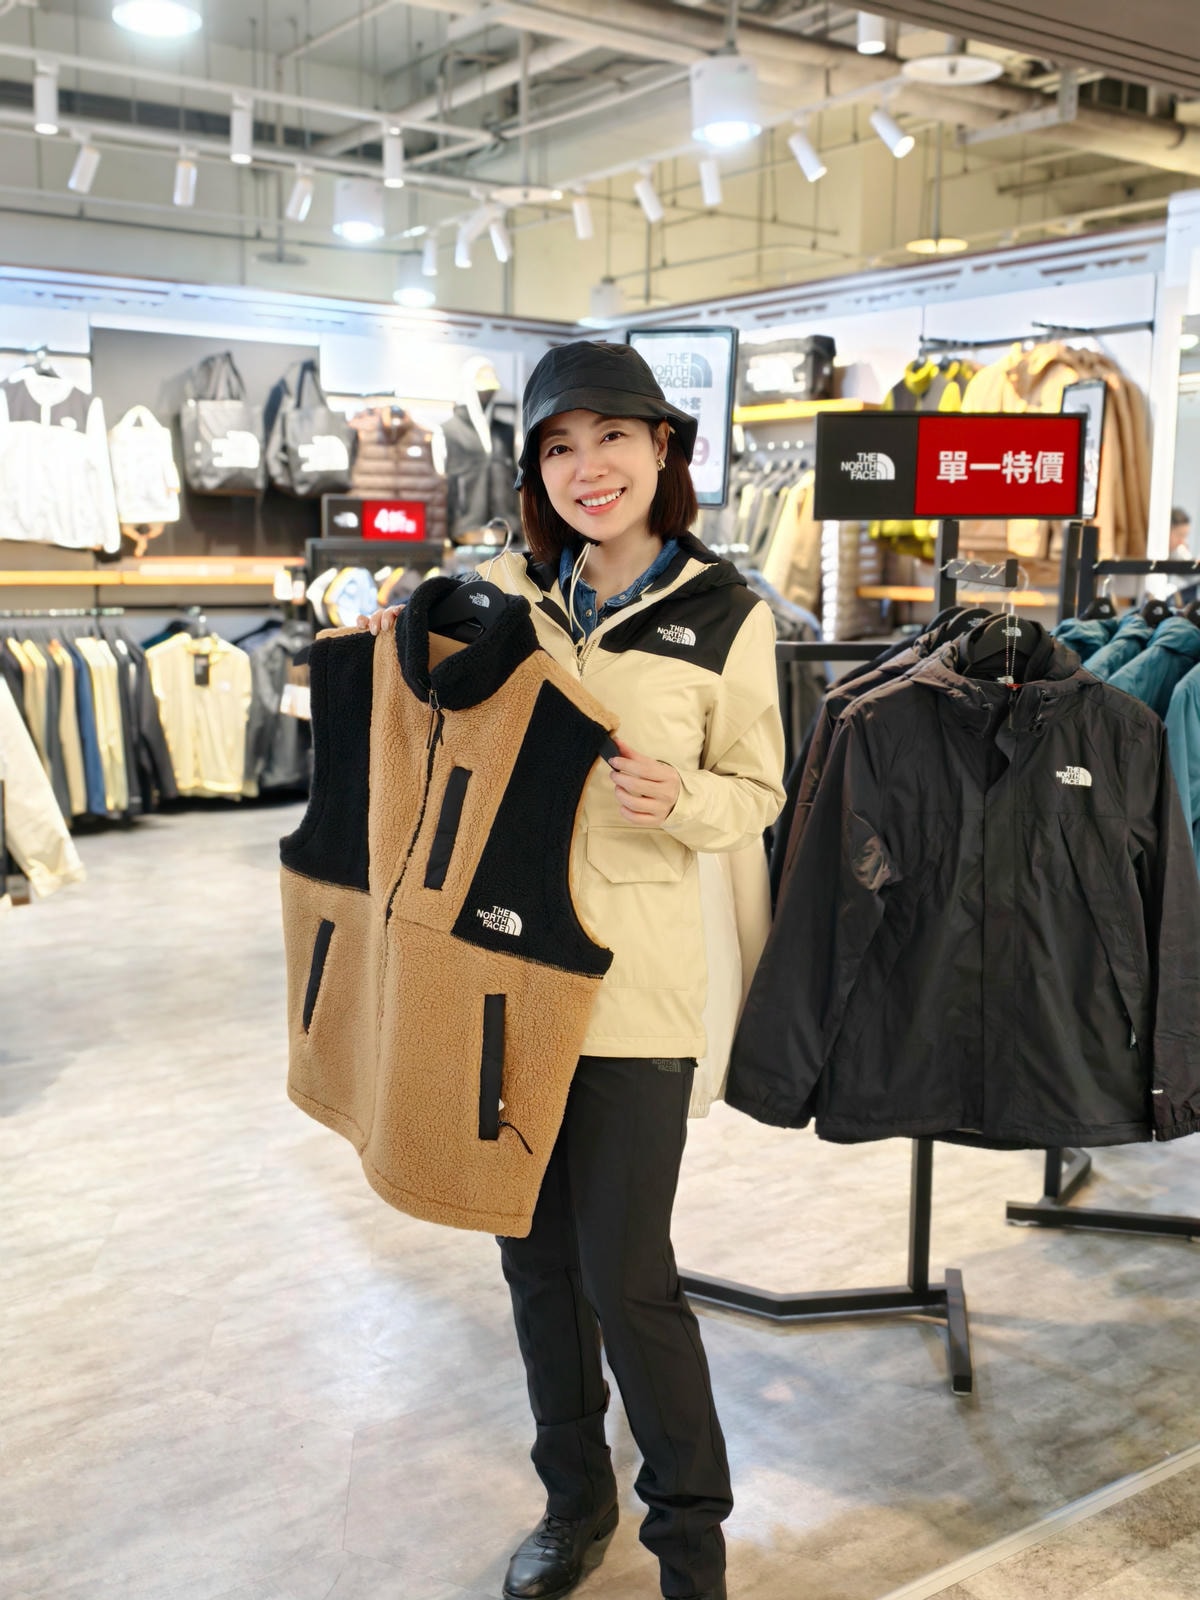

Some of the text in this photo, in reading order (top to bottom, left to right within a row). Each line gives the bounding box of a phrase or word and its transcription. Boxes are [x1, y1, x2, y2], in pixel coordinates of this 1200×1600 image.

[667, 353, 689, 364] THE
[658, 377, 688, 388] FACE
[857, 452, 877, 462] THE
[841, 461, 877, 471] NORTH
[936, 450, 1064, 484] 單一特價
[851, 470, 877, 480] FACE
[657, 627, 684, 639] NORTH
[670, 624, 685, 634] THE
[662, 634, 682, 644] FACE
[1066, 765, 1080, 773] THE
[1056, 770, 1080, 780] NORTH
[1061, 778, 1080, 786] FACE
[492, 905, 510, 918] THE
[476, 909, 508, 925] NORTH
[482, 919, 506, 932] FACE
